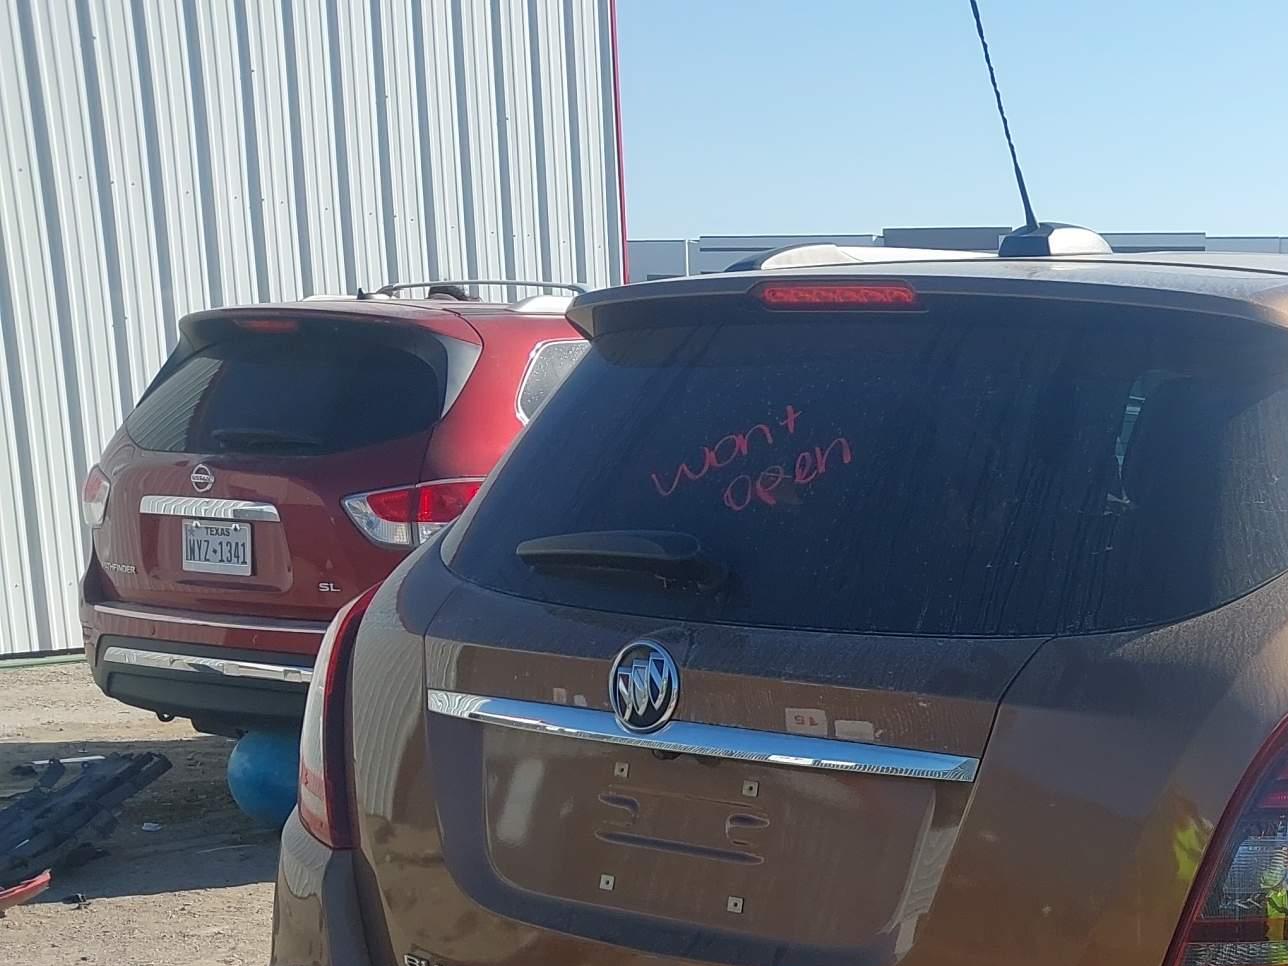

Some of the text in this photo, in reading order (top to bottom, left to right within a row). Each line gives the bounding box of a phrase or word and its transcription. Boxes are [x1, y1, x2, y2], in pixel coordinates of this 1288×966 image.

[723, 437, 851, 511] open
[205, 527, 231, 537] TEXAS
[319, 582, 341, 592] SL
